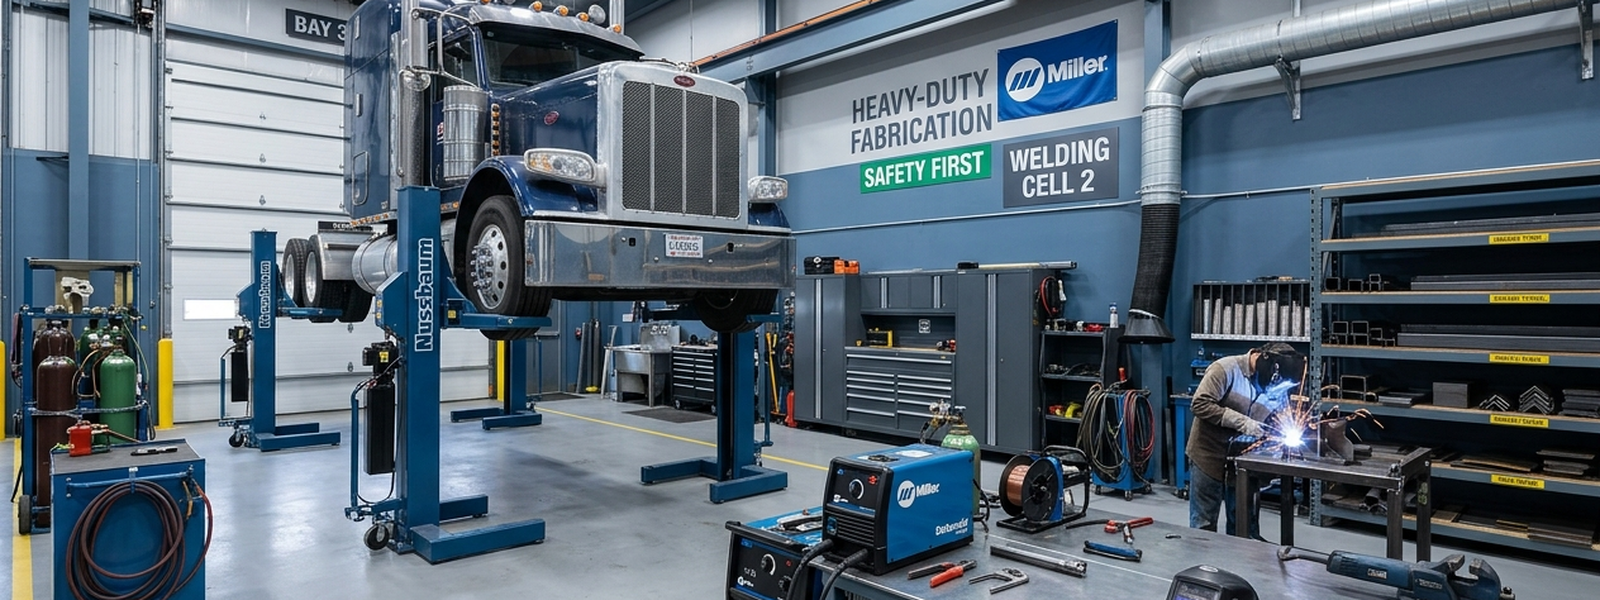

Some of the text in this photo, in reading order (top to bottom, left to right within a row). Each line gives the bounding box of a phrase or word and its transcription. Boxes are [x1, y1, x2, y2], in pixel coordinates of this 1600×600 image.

[294, 15, 346, 41] BAY 3
[852, 68, 989, 124] HEAVY-DUTY
[851, 103, 992, 154] FABRICATION
[864, 150, 984, 188] SAFETY FIRST
[1009, 136, 1110, 172] WELDING
[1022, 168, 1095, 199] CELL 2
[414, 238, 434, 352] Nussbaum
